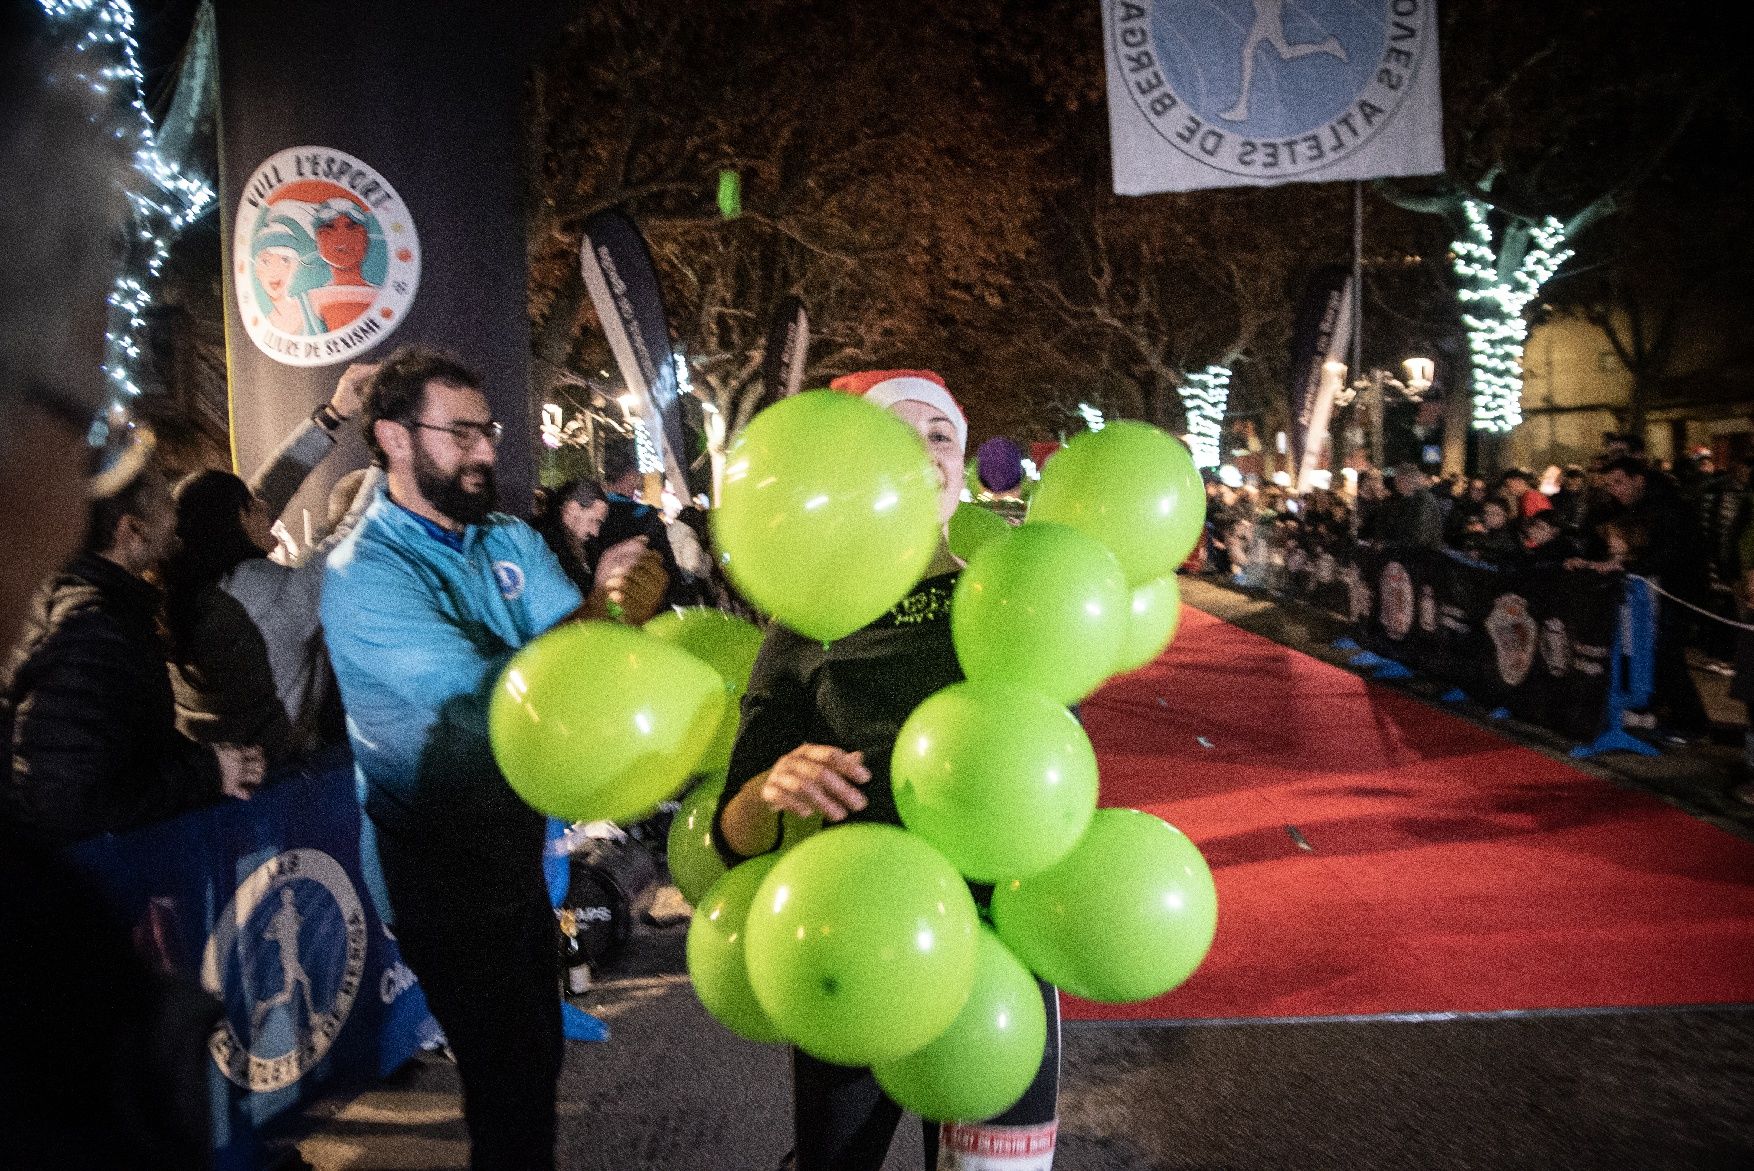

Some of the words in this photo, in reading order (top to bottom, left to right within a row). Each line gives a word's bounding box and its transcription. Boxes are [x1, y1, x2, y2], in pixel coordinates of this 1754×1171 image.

[248, 164, 283, 208] VULL
[294, 153, 391, 208] L'ESPORT
[304, 341, 321, 358] DE
